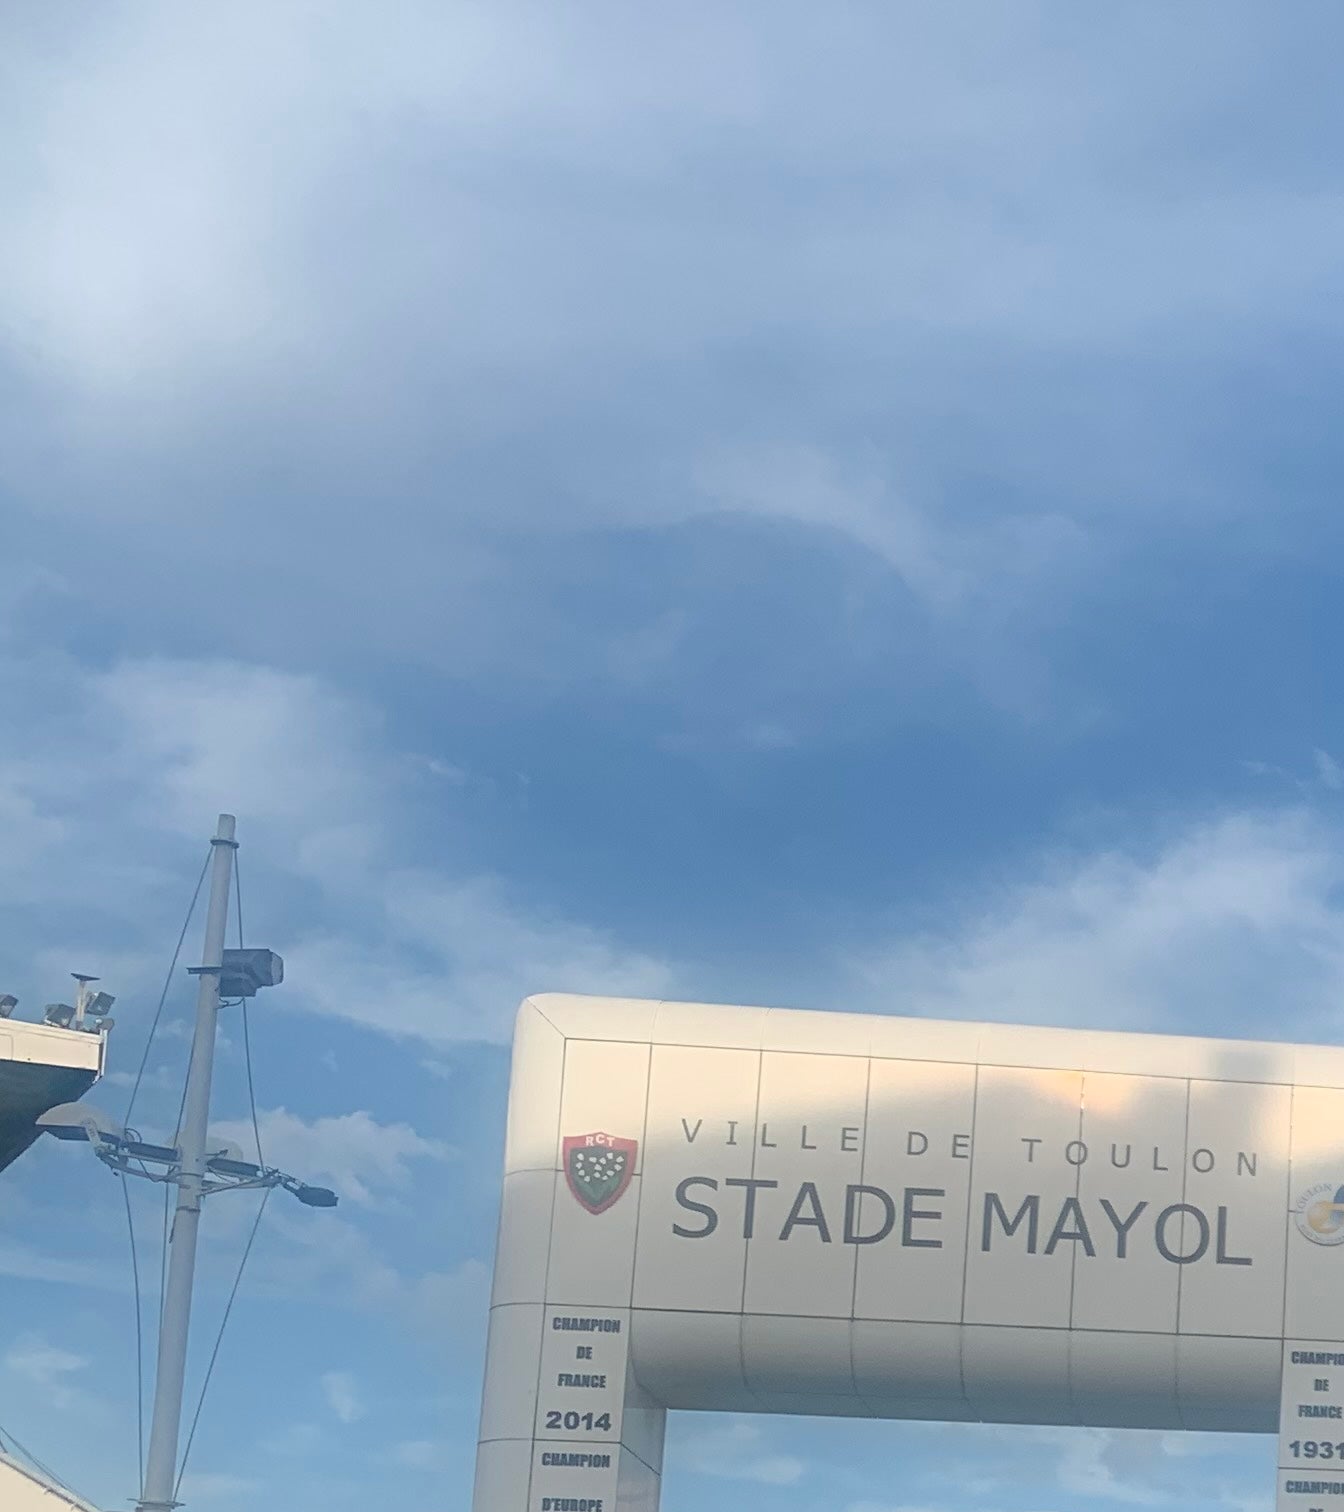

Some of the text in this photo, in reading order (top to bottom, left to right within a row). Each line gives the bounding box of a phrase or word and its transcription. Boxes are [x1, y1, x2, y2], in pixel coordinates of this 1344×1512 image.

[585, 1134, 616, 1147] RCT
[681, 1118, 1257, 1177] VILLE DE TOULON
[672, 1176, 1253, 1266] STADE MAYOL
[552, 1316, 621, 1333] CHAMPION
[576, 1346, 593, 1360] DE
[557, 1373, 607, 1389] FRANCE
[1314, 1379, 1329, 1392] DE
[1298, 1404, 1343, 1419] FRANCE
[545, 1410, 612, 1431] 2014
[541, 1452, 610, 1468] CHAMPION
[541, 1497, 603, 1512] D'EUROPE
